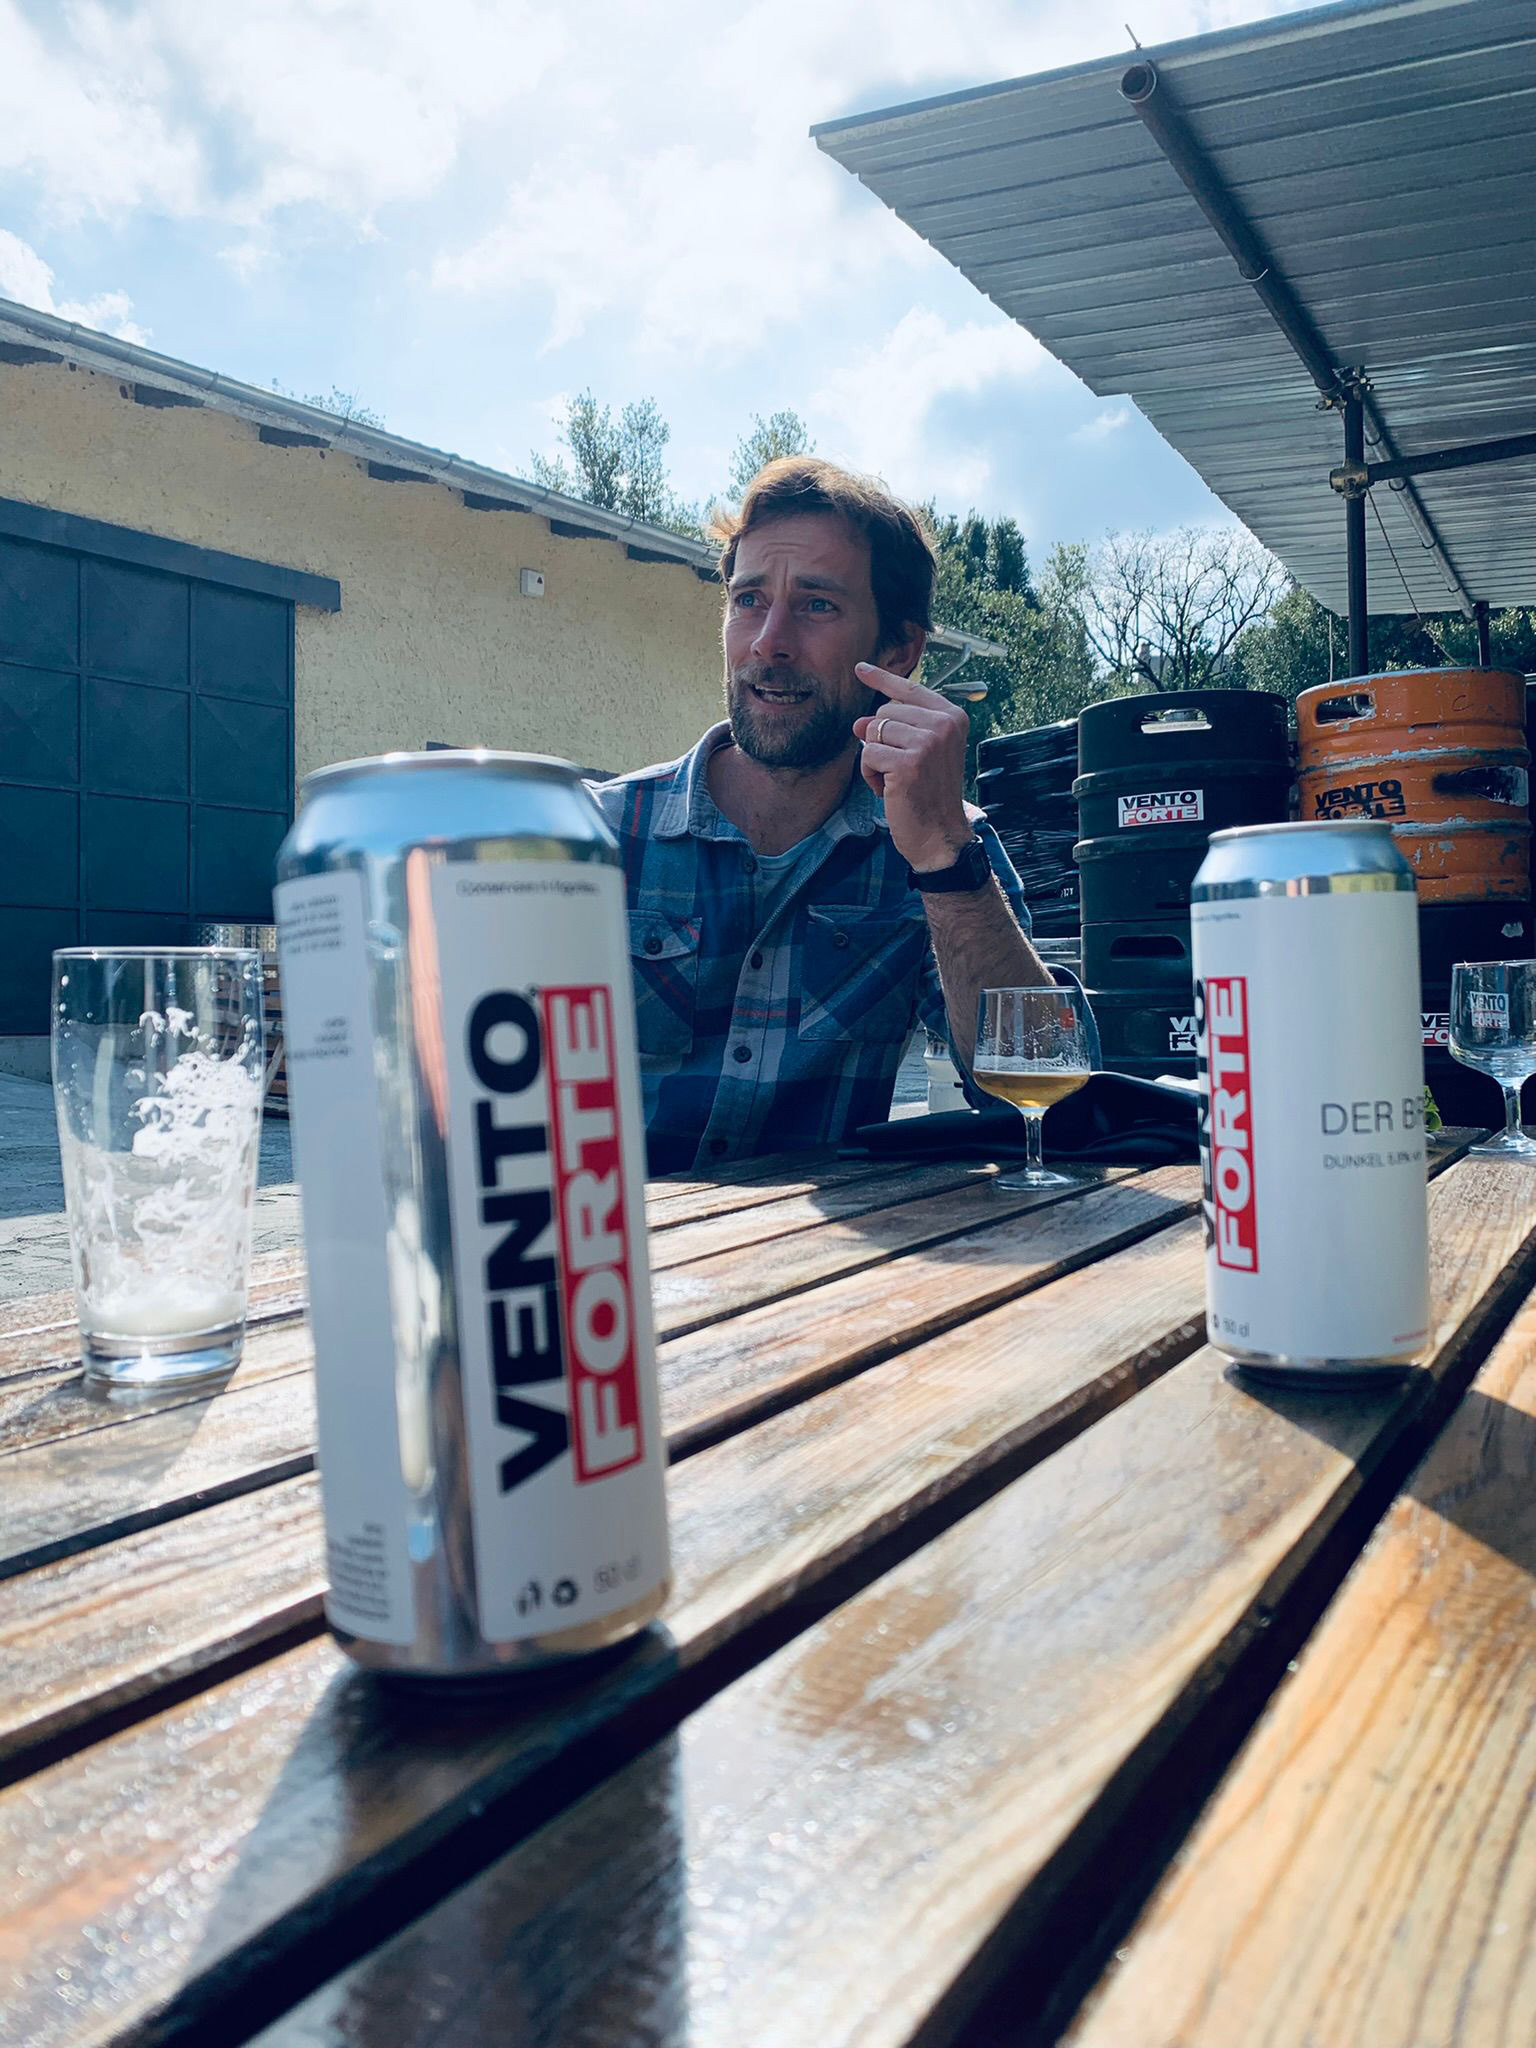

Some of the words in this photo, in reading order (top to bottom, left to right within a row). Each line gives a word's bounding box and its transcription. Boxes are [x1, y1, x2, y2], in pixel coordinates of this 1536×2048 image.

[1123, 791, 1197, 809] VENTO
[1315, 780, 1402, 808] VENTO
[1123, 805, 1198, 825] FORTE
[1471, 993, 1506, 1011] VENTO
[1208, 979, 1255, 1270] FORTE
[1321, 1101, 1394, 1135] DER
[1323, 1153, 1385, 1170] DUNKEL
[468, 990, 571, 1496] VENTO
[550, 987, 642, 1481] FORTE
